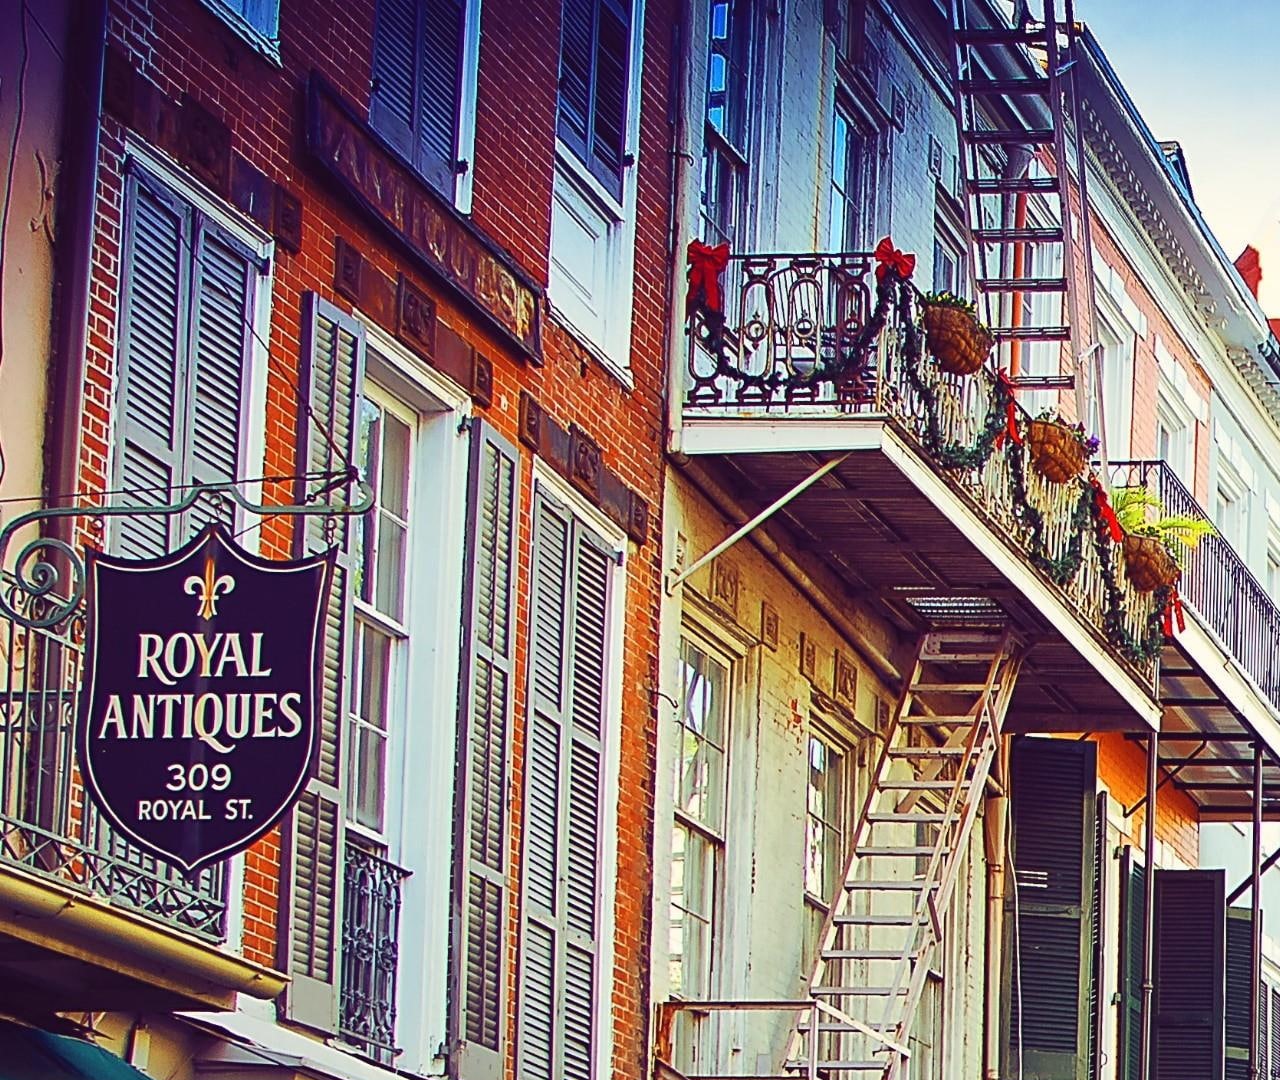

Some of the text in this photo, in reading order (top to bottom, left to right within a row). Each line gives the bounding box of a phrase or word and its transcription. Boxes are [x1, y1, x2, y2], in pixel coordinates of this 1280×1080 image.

[137, 632, 272, 686] ROYAL
[99, 692, 303, 754] ANTIQUES
[165, 763, 233, 792] 309
[138, 798, 254, 821] ROYAL ST.
